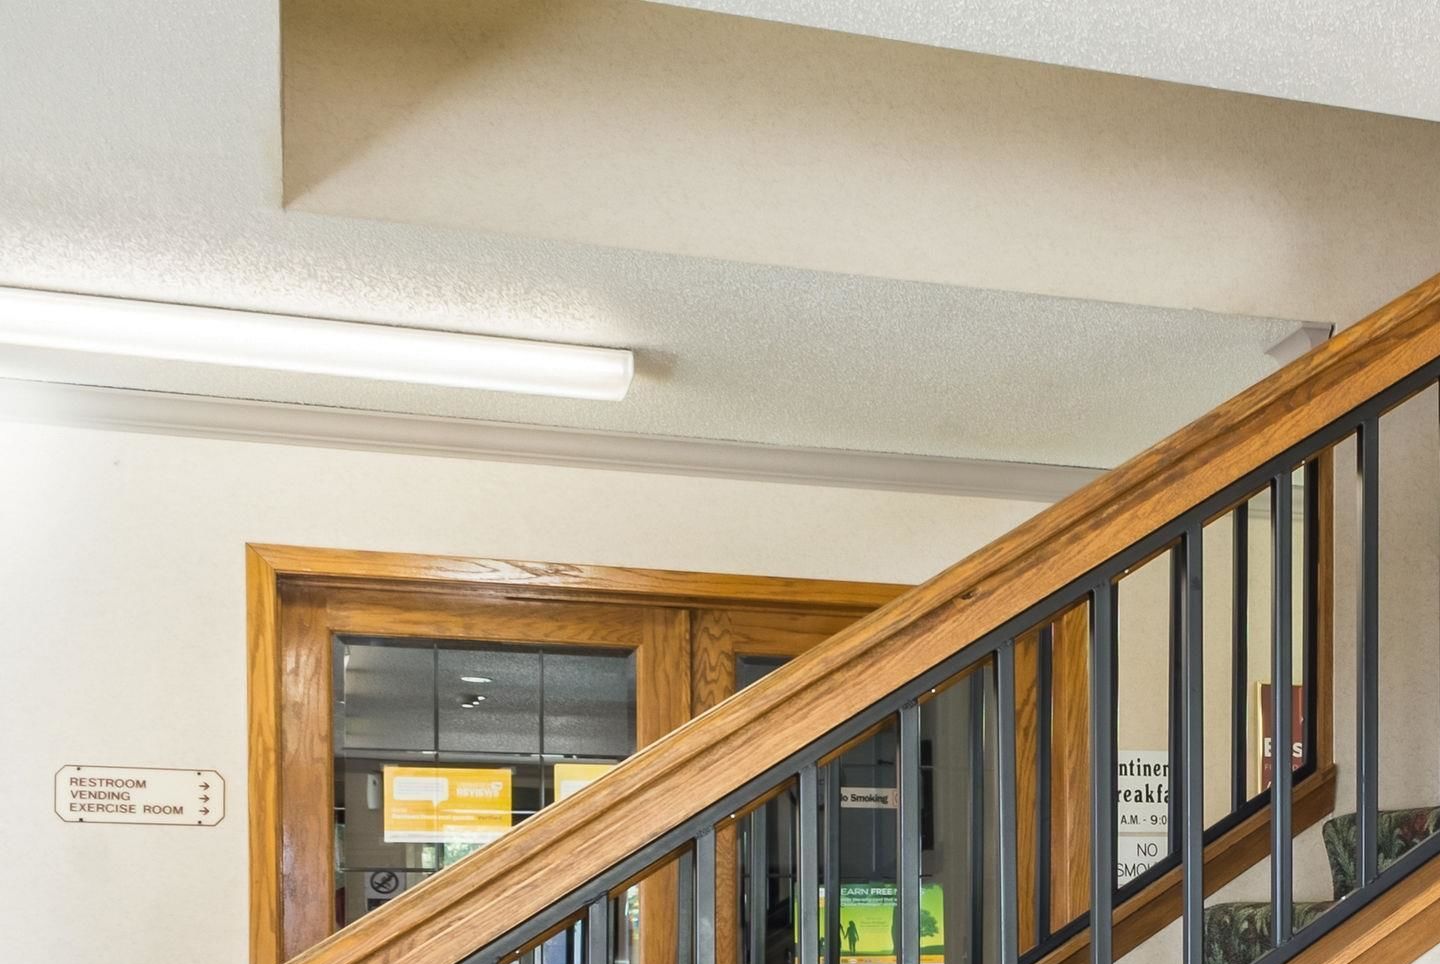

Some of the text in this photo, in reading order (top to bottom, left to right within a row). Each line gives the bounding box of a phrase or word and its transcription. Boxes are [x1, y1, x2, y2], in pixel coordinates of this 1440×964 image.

[70, 777, 147, 789] RESTROOM
[70, 790, 131, 801] VENDING
[850, 794, 889, 804] Smoking
[69, 803, 184, 815] EXERCISE ROOM
[1150, 815, 1168, 825] 9:0
[1137, 843, 1158, 857] NO
